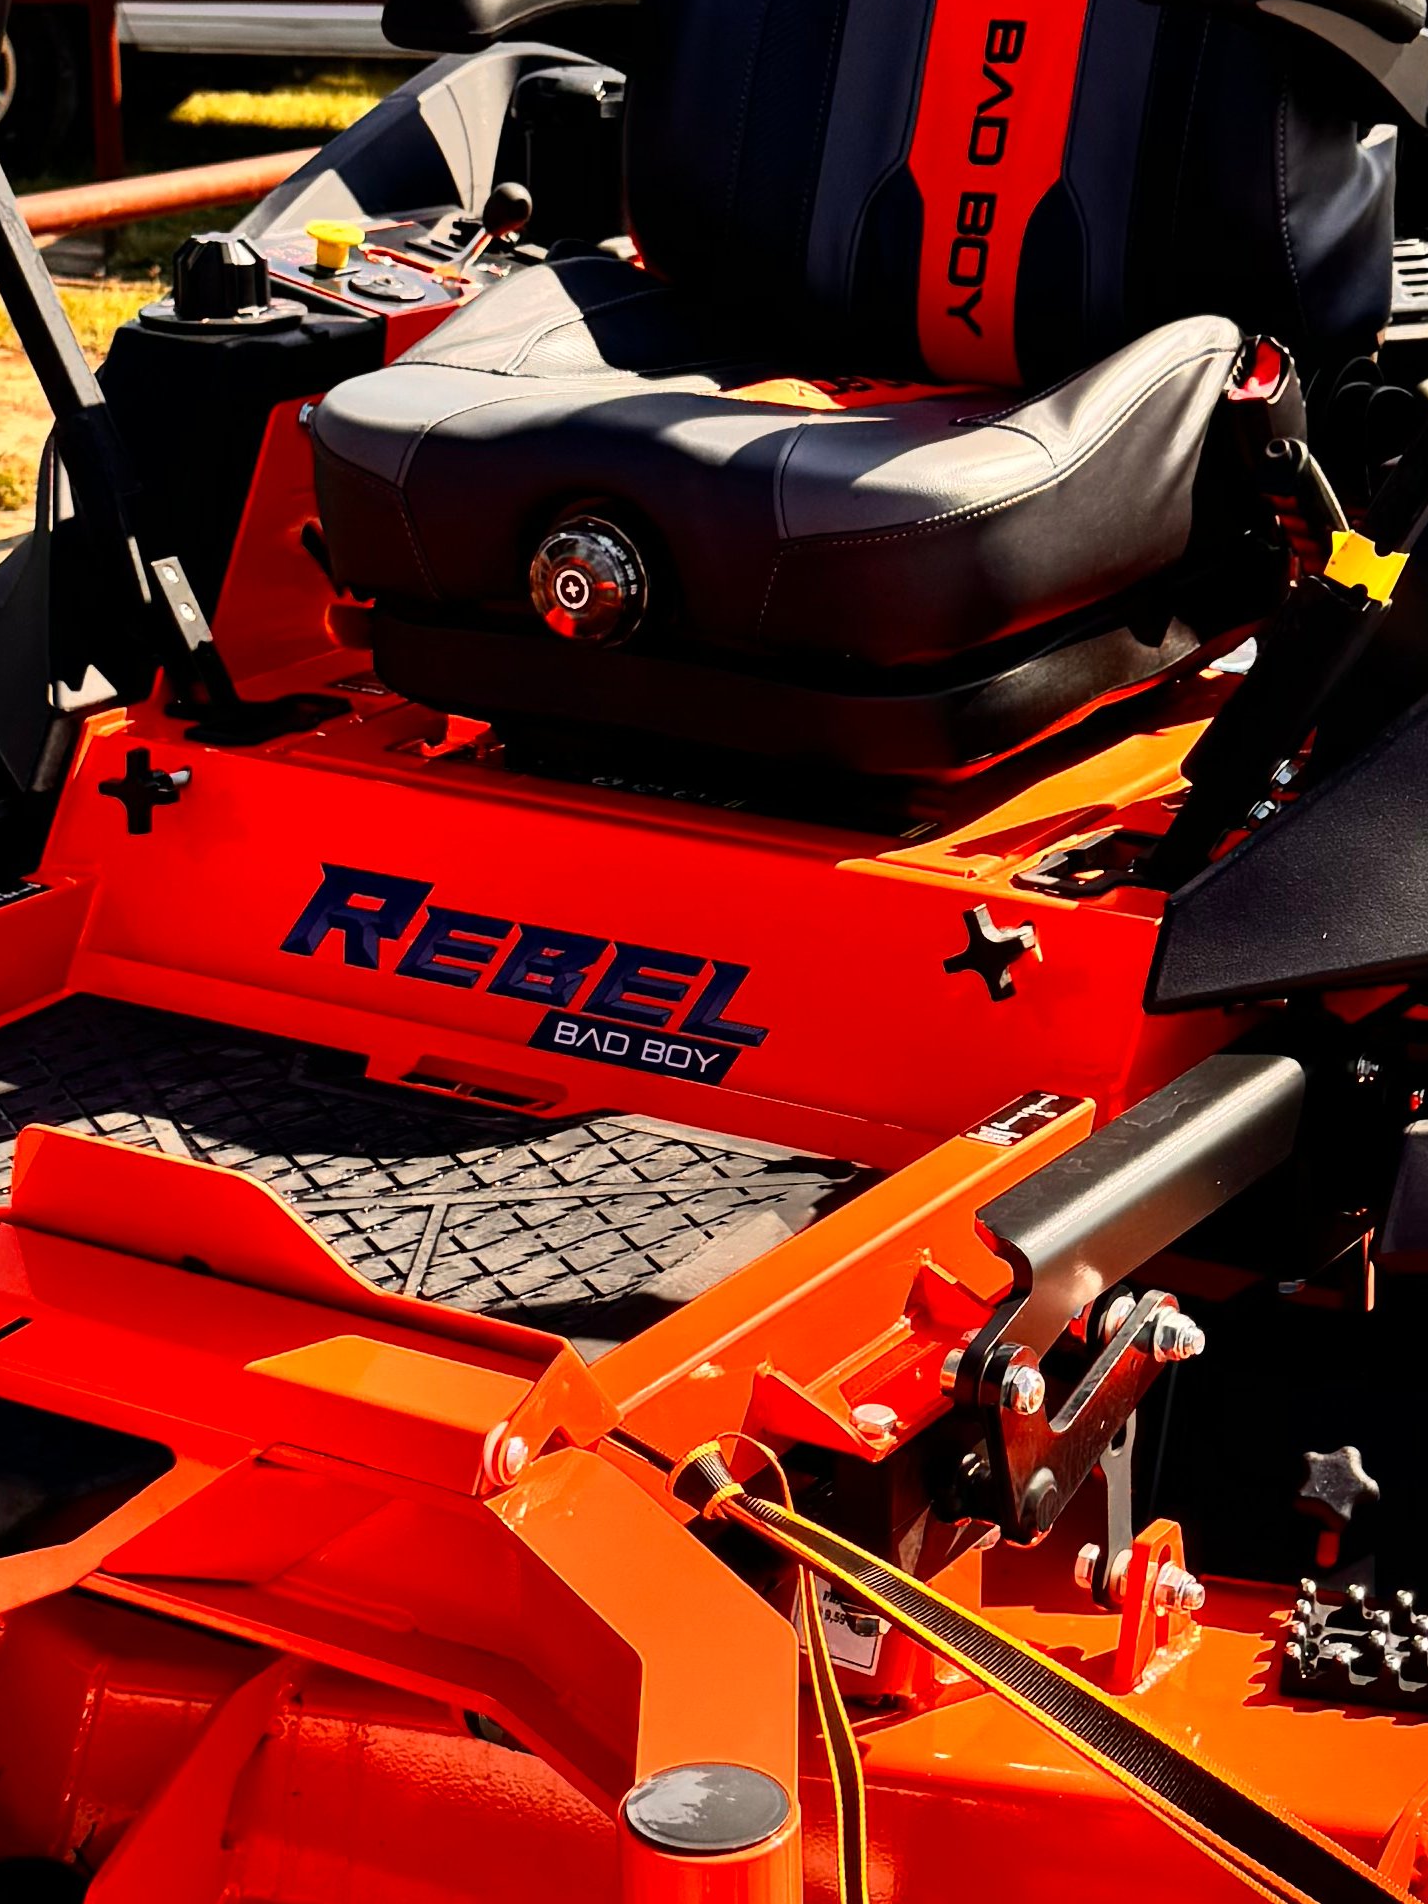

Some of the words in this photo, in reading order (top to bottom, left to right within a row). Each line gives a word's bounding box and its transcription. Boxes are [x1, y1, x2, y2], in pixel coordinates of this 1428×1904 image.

[968, 19, 1028, 167] BAD
[946, 191, 998, 338] BOY
[279, 862, 770, 1047] REBEL
[553, 1020, 630, 1058] BAD
[639, 1037, 721, 1074] BOY
